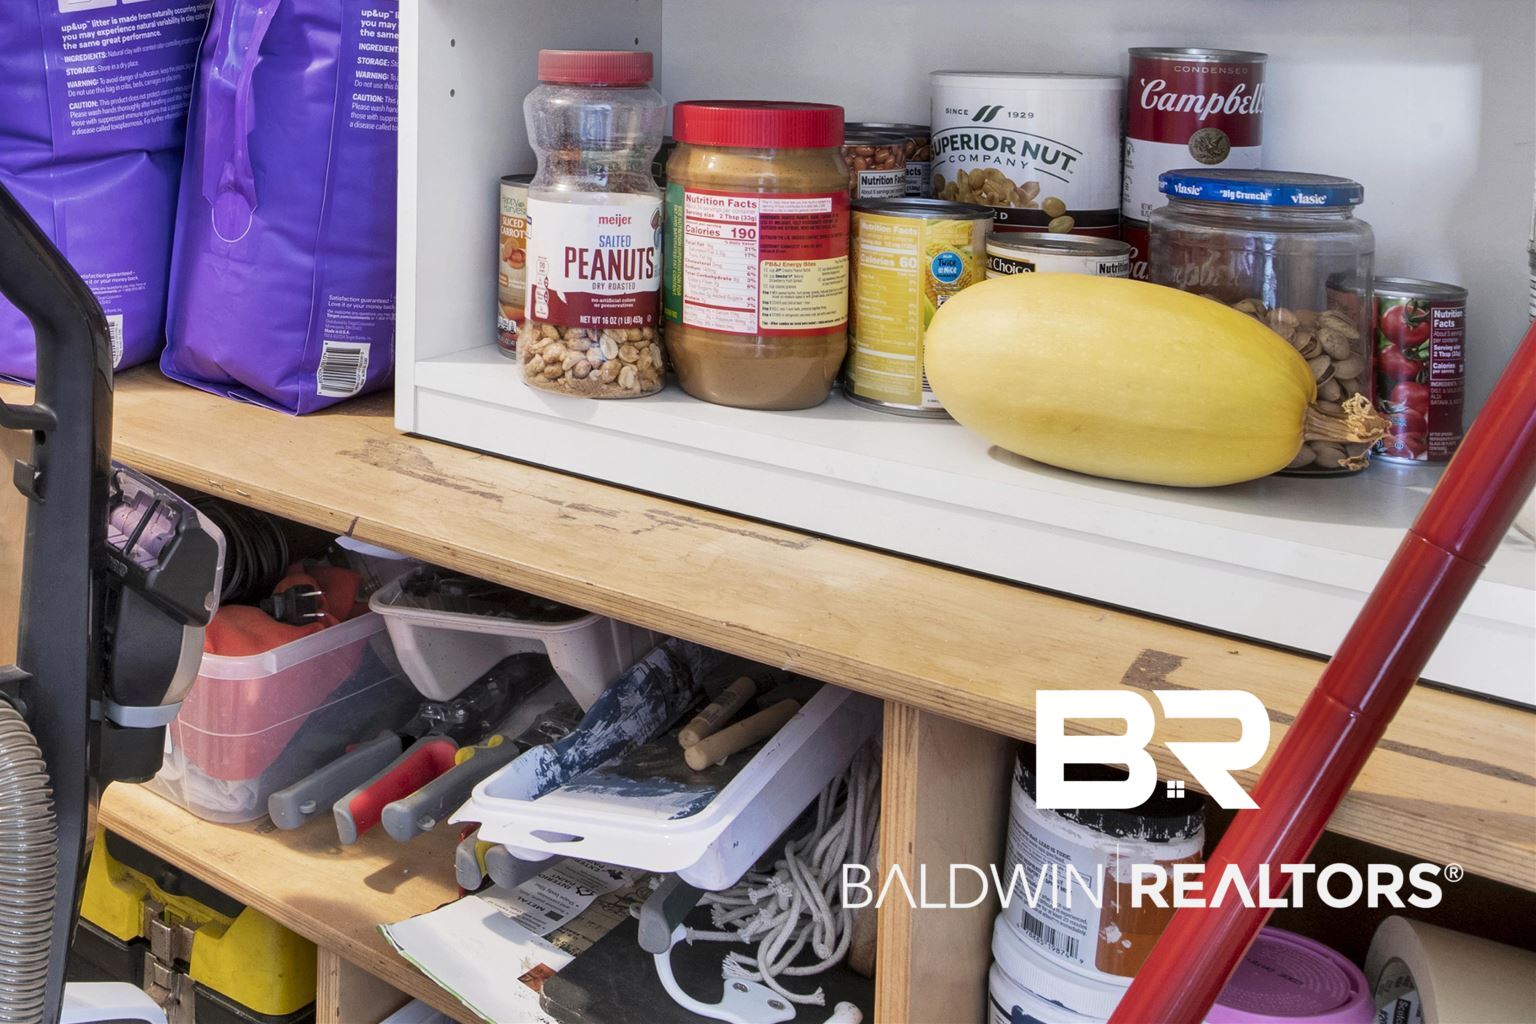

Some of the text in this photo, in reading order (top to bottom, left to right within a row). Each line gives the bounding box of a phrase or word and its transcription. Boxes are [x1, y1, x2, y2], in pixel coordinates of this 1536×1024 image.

[92, 18, 110, 28] litter
[119, 16, 137, 24] made
[138, 13, 151, 21] from
[360, 19, 397, 30] you may
[62, 20, 156, 42] you may experience natural
[360, 29, 375, 37] the
[63, 31, 162, 50] the same great performance.
[358, 42, 399, 53] INGREDIENT
[64, 51, 108, 63] INGREDIENTS:
[357, 56, 389, 67] STORAGE:
[66, 66, 97, 76] STORAGE:
[355, 70, 389, 81] WARNING:
[1174, 65, 1248, 75] CONDENSED
[67, 79, 99, 89] WARNING:
[352, 93, 384, 103] CAUTION:
[1140, 78, 1264, 120] Campbell
[69, 100, 98, 109] CAUTION:
[945, 107, 1034, 119] SINCE 1929
[931, 133, 1016, 161] SUPERIOR
[948, 154, 1030, 169] COMPANY
[905, 167, 922, 176] acts
[861, 175, 894, 185] Nutrition
[686, 194, 724, 206] Nutrition
[728, 199, 757, 209] Facts
[599, 214, 632, 227] meijer
[501, 225, 526, 239] CARROT
[685, 224, 756, 239] Calories 190
[599, 235, 631, 247] SALTED
[565, 246, 654, 280] PEANUTS
[899, 257, 917, 268] 60
[937, 258, 956, 267] Twice
[592, 282, 635, 290] DRY ROASTED
[1434, 309, 1463, 318] Nutrition
[580, 315, 591, 324] NET
[591, 316, 601, 324] WT
[610, 317, 617, 325] OZ
[1434, 320, 1455, 328] Facts
[538, 873, 572, 890] INTERIO
[516, 895, 546, 912] METAL
